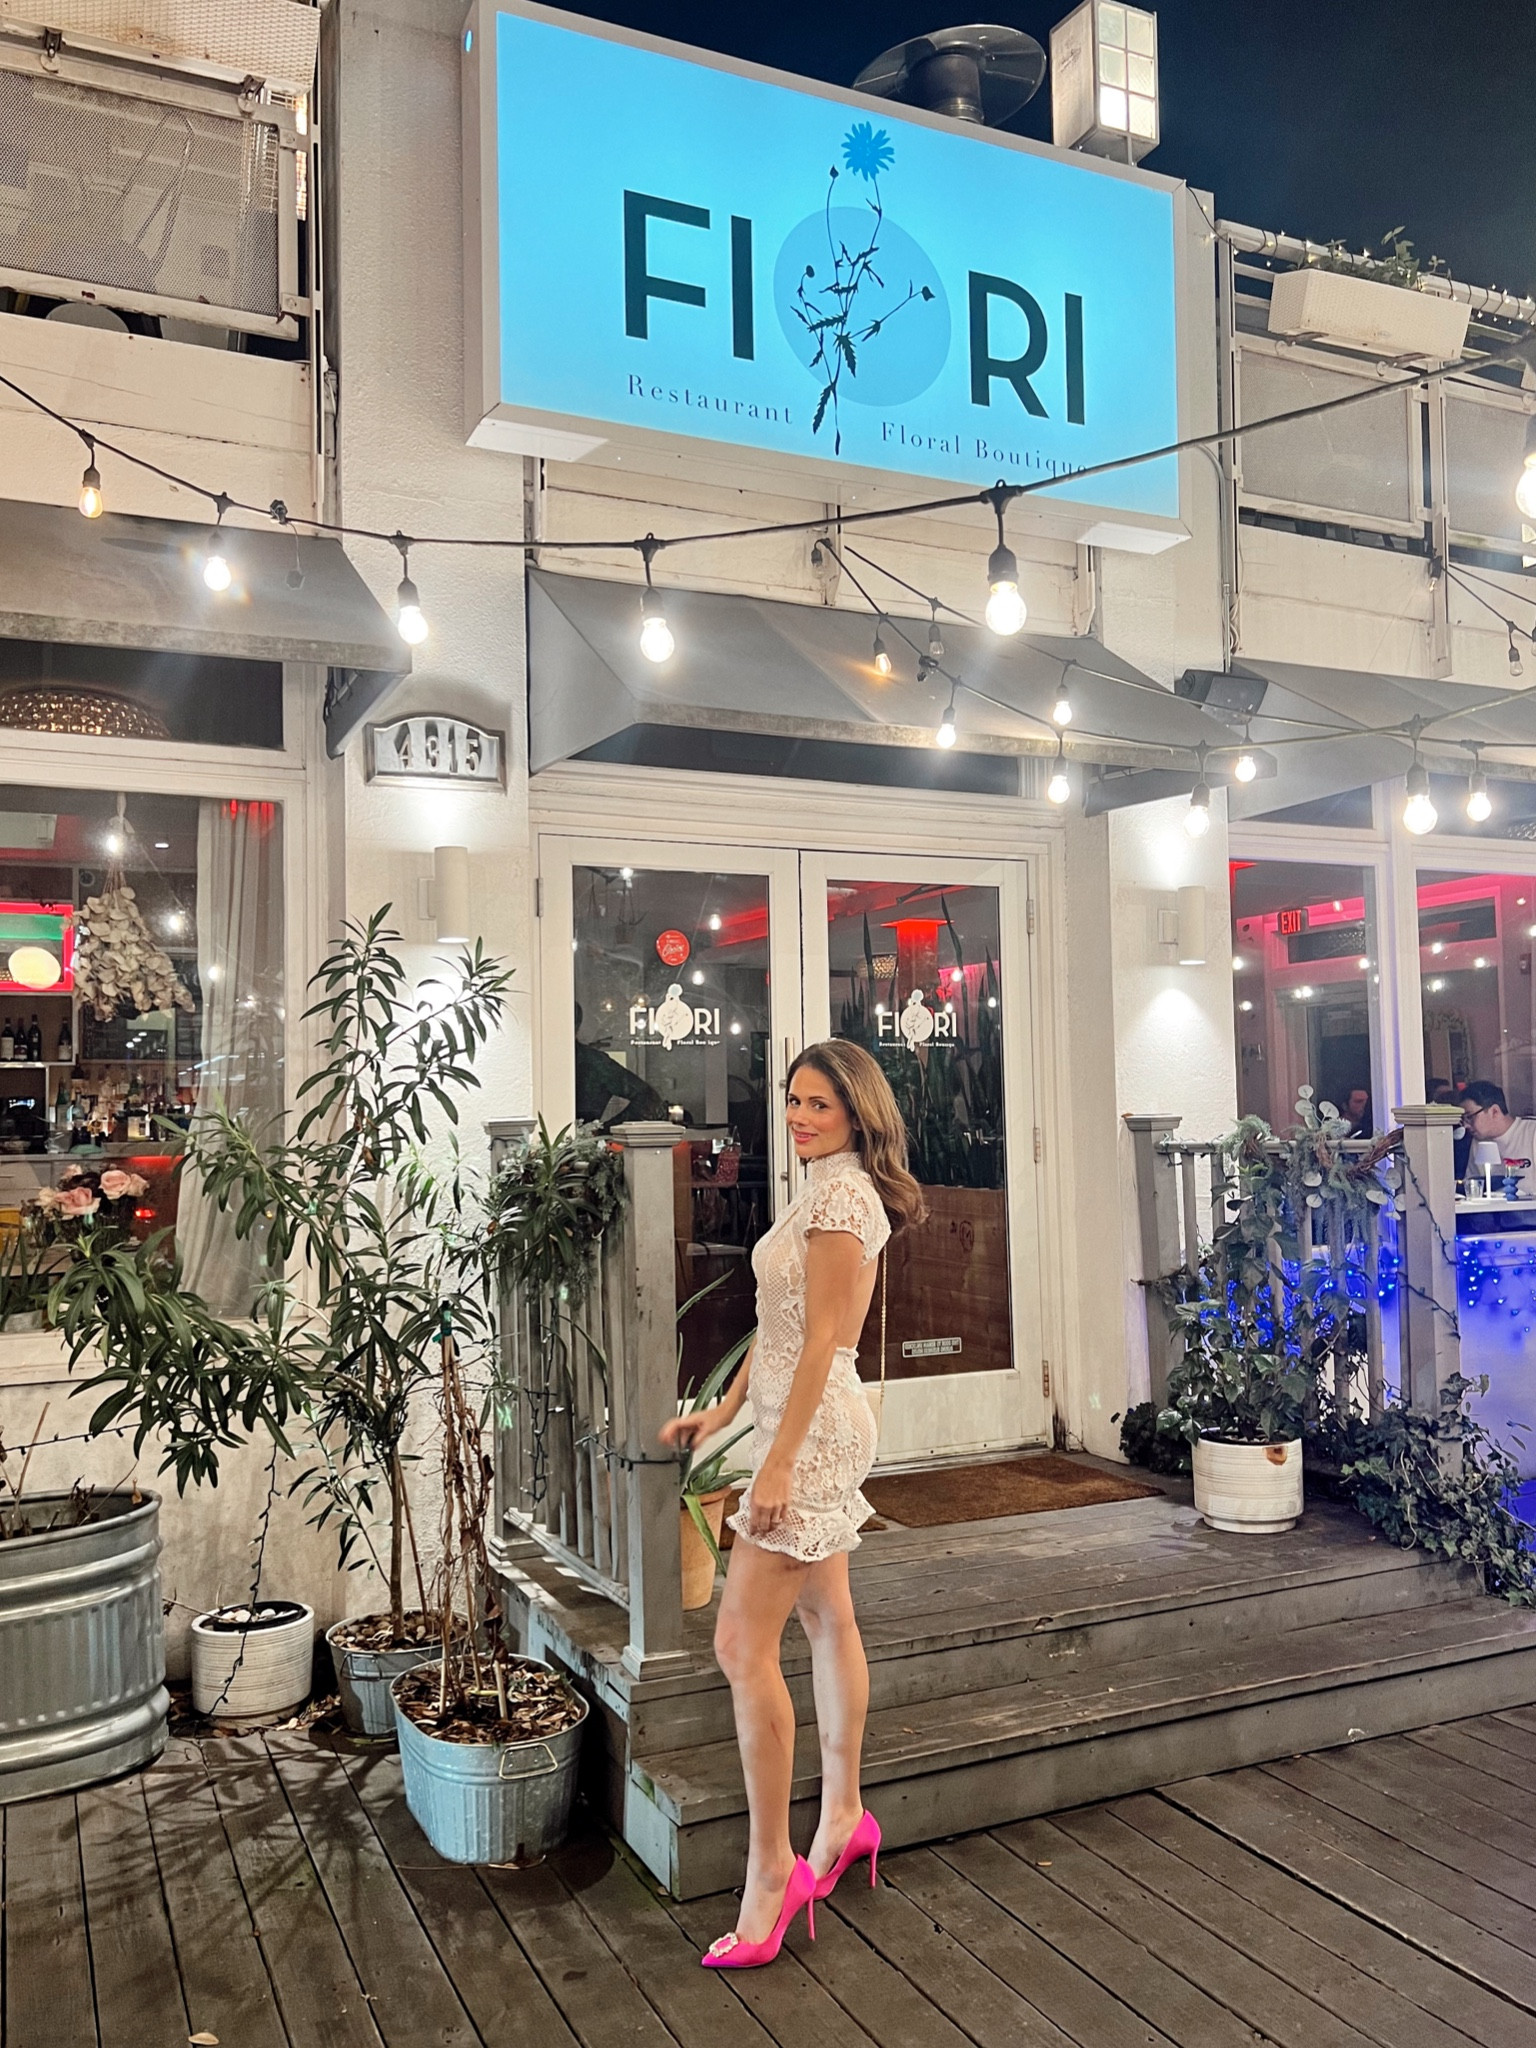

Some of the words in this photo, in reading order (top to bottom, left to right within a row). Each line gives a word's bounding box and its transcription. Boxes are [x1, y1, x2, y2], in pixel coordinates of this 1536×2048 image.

[622, 189, 1086, 426] FIORI
[627, 373, 793, 425] Restaurant
[881, 421, 960, 454] Floral
[399, 733, 480, 775] 4315
[1281, 909, 1301, 934] EXIT
[629, 1000, 720, 1040] FIORI
[877, 1004, 957, 1041] FIORI
